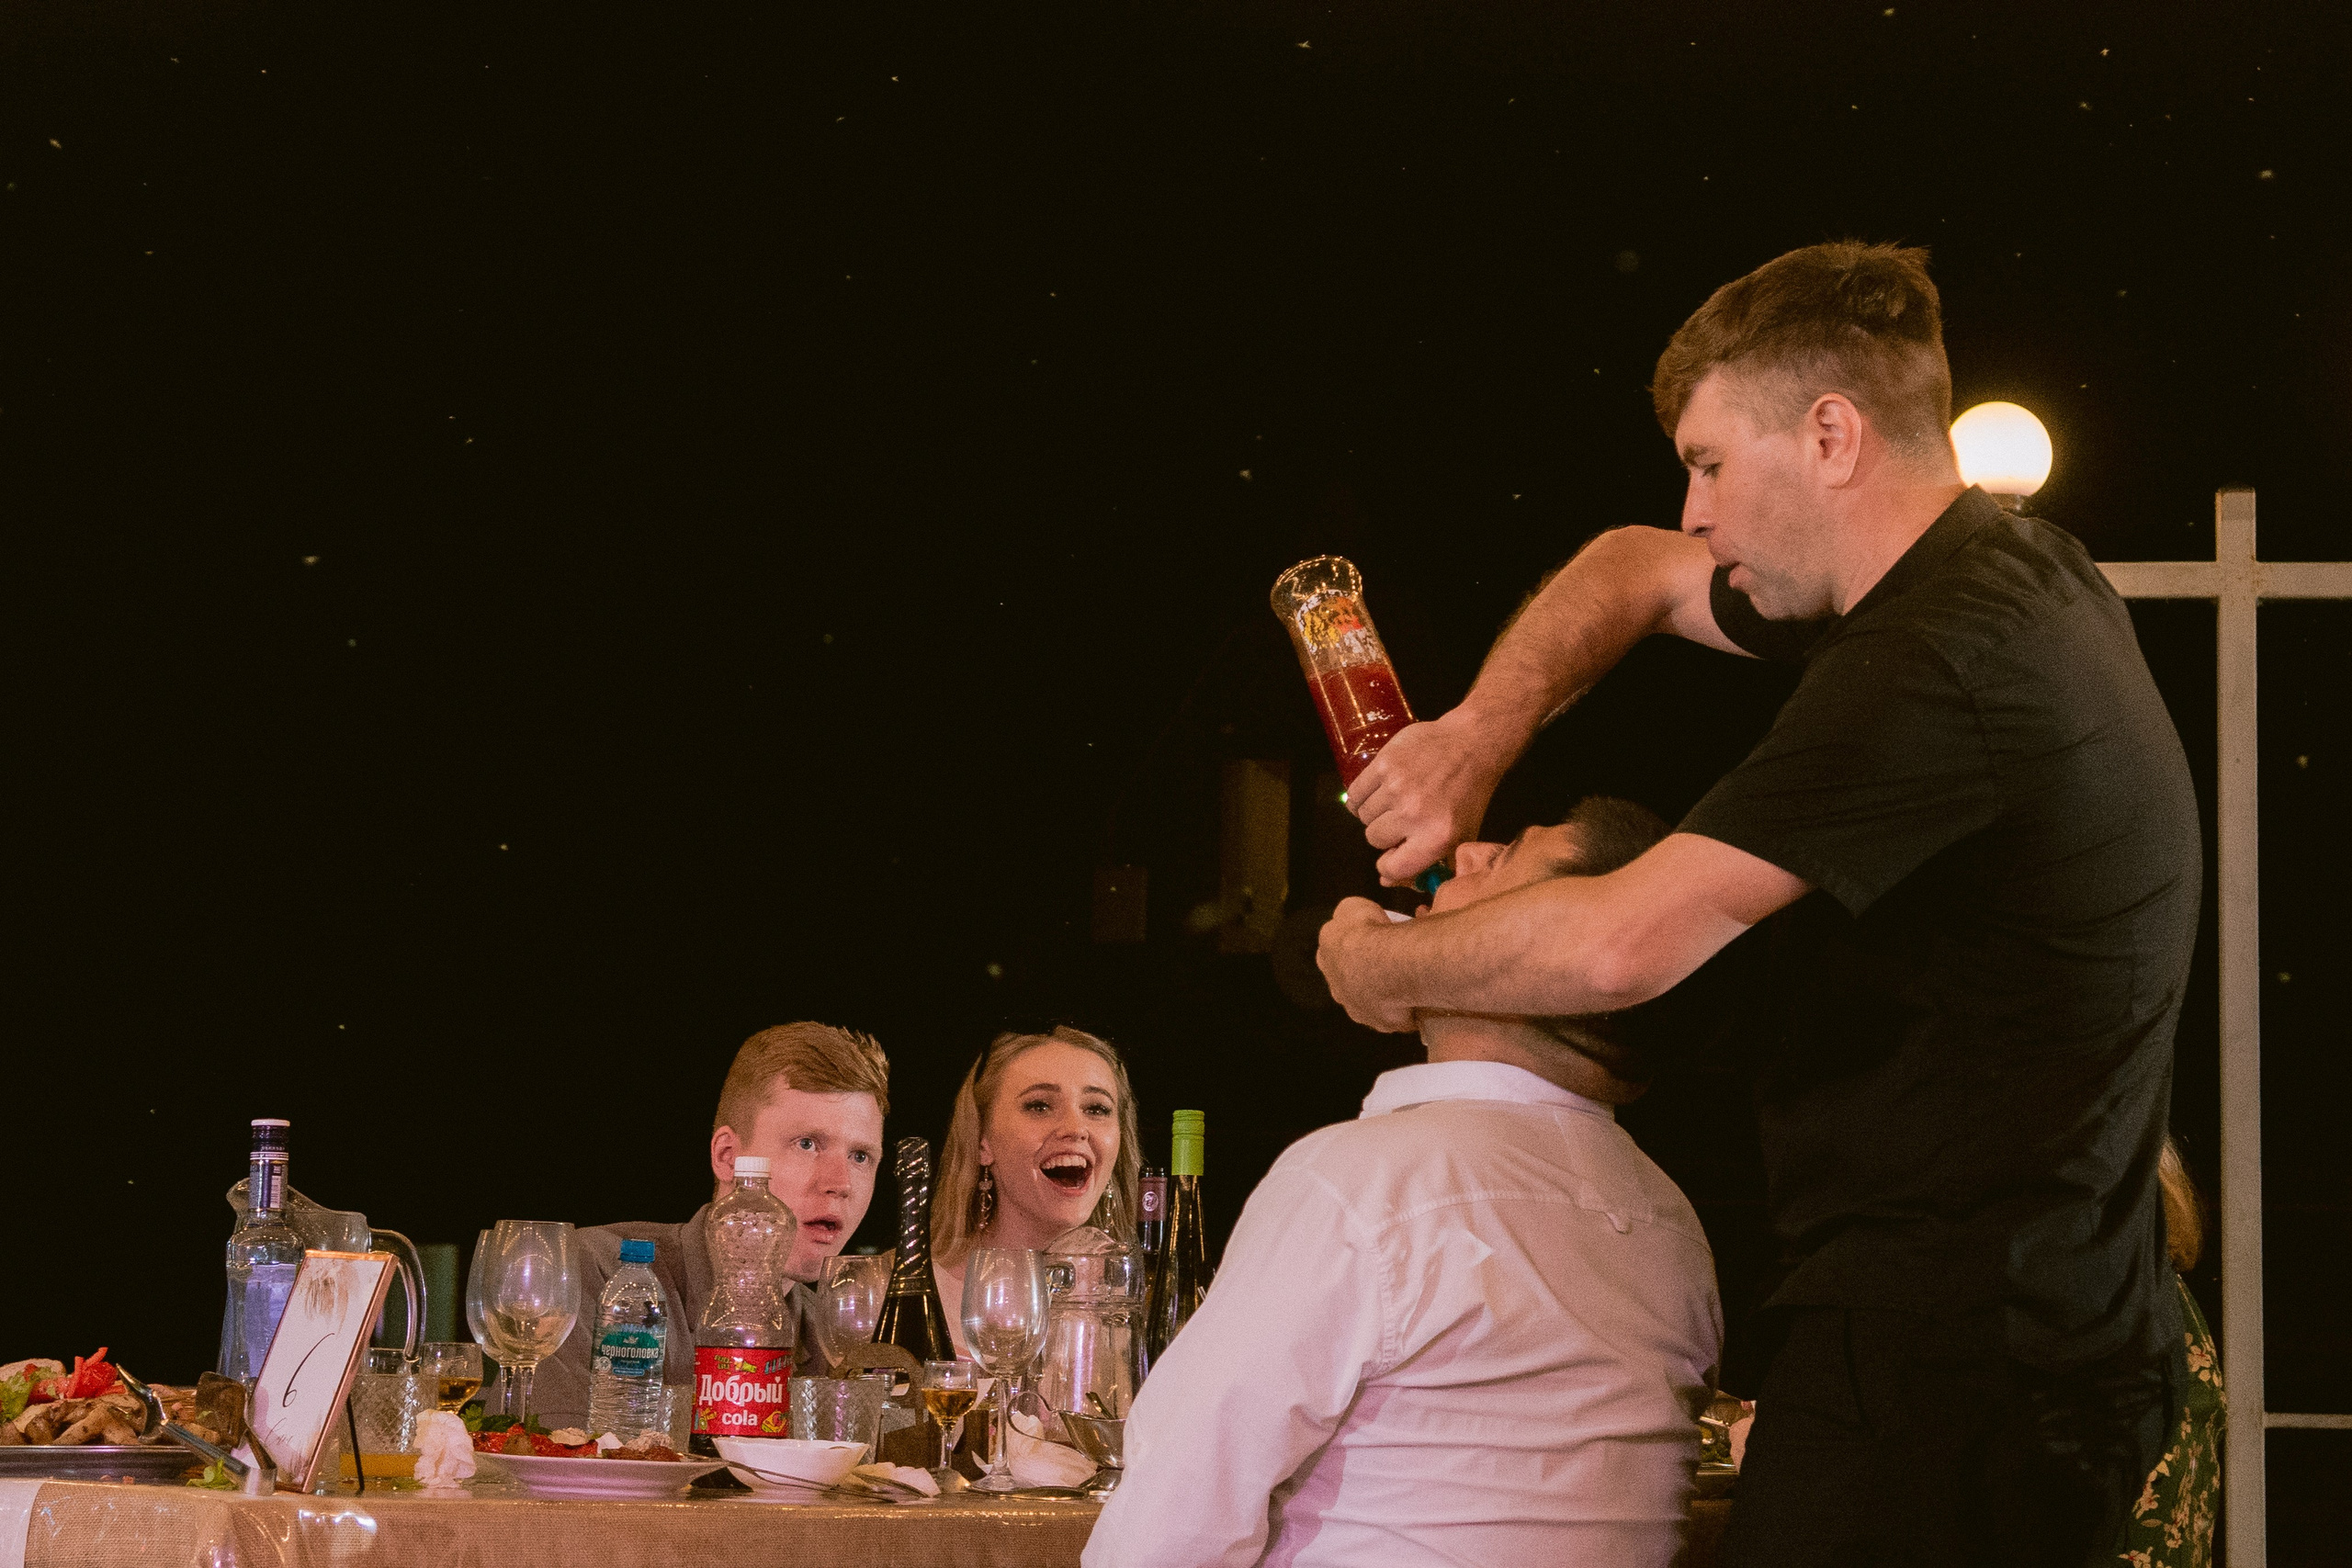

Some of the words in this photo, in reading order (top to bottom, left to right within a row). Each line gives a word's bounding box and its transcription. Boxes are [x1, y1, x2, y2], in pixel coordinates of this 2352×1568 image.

[282, 1332, 335, 1408] 6
[698, 1374, 784, 1407] Добрый
[721, 1409, 758, 1426] cola
